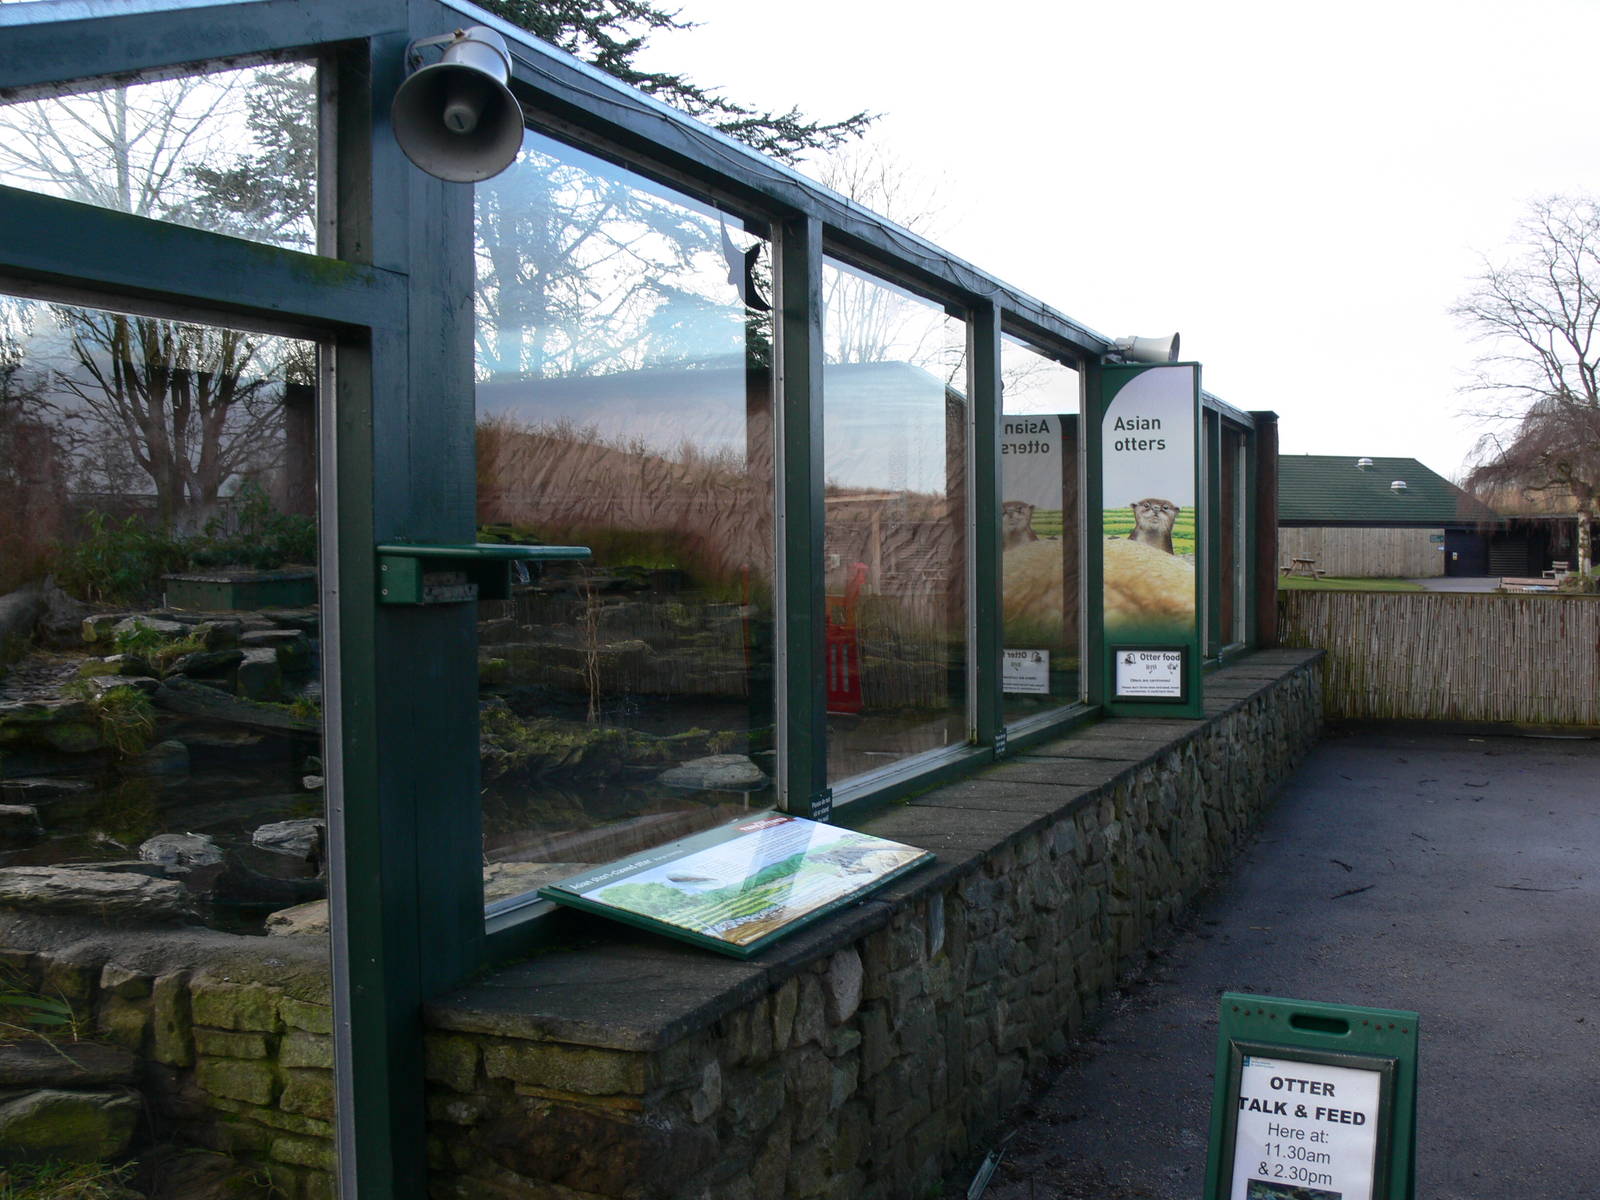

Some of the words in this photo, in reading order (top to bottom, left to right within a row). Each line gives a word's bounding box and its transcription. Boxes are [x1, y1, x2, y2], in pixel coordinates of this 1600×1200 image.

[1114, 415, 1161, 431] Asian
[1114, 437, 1166, 452] otters
[1139, 652, 1161, 662] Otter
[1270, 1076, 1336, 1097] OTTER
[1238, 1096, 1287, 1116] TALK
[1294, 1104, 1308, 1118] &
[1315, 1107, 1366, 1126] FEED
[1267, 1122, 1305, 1140] Here
[1310, 1129, 1329, 1143] at:
[1264, 1142, 1331, 1165] 11.30am
[1258, 1161, 1270, 1176] &
[1274, 1163, 1332, 1186] 2.30pm
